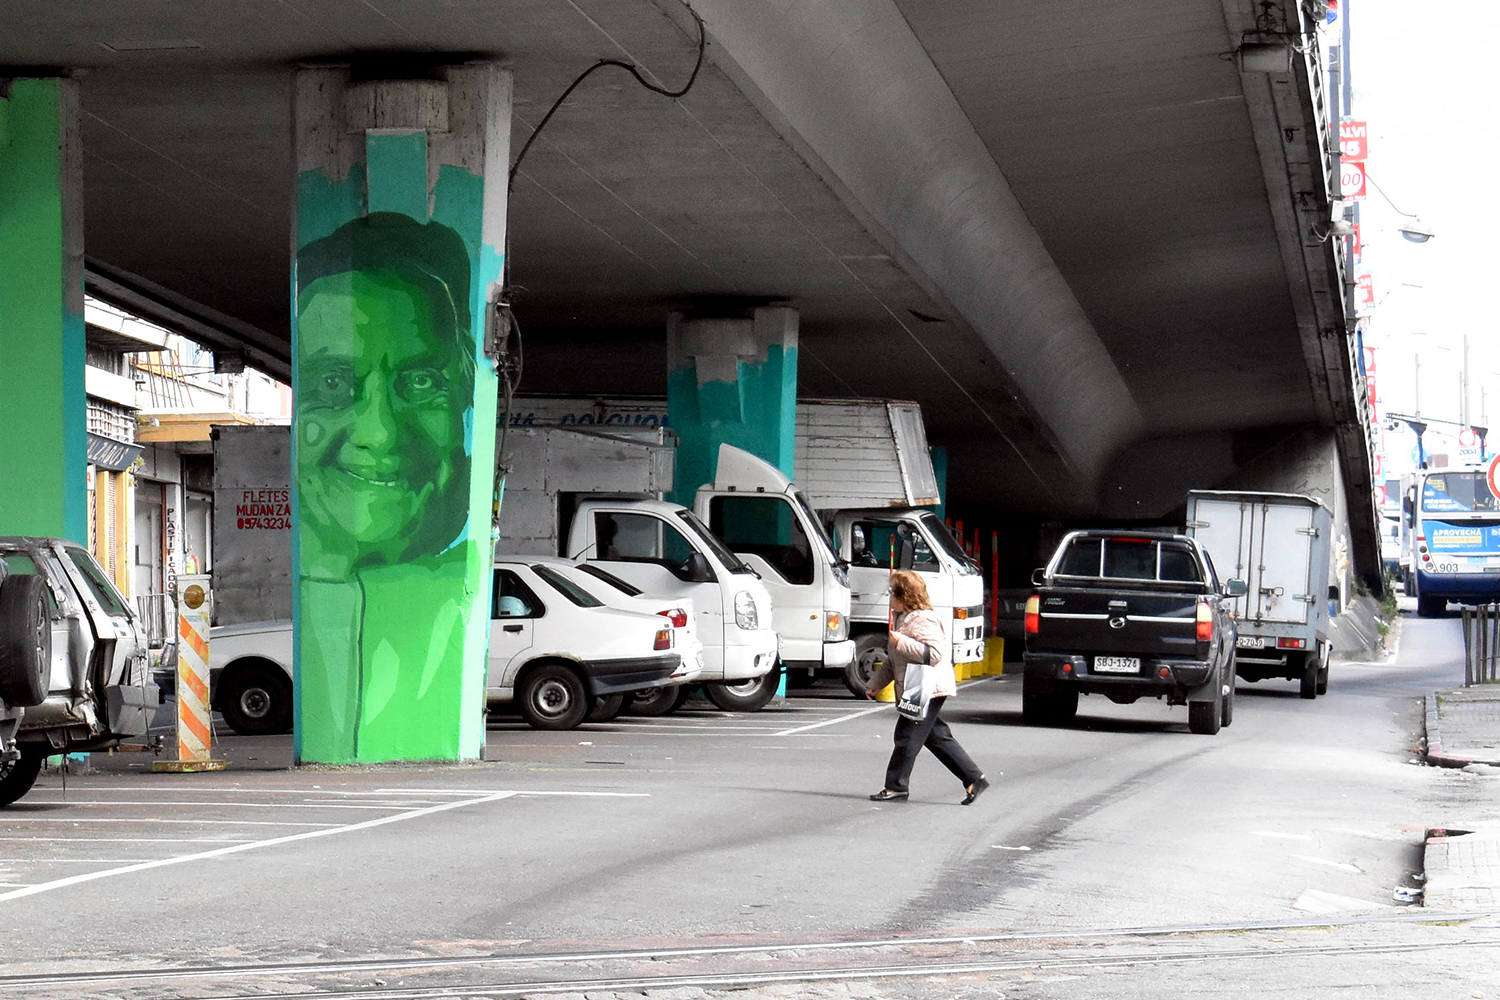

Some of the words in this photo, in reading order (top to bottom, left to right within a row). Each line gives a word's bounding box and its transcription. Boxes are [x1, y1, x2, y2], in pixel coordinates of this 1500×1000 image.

[1340, 126, 1365, 137] ALVI
[1342, 173, 1361, 186] 00
[87, 438, 129, 466] ALZADOS
[243, 491, 289, 503] FLETES
[1440, 564, 1458, 573] 903
[1096, 657, 1137, 668] SBJ-1326
